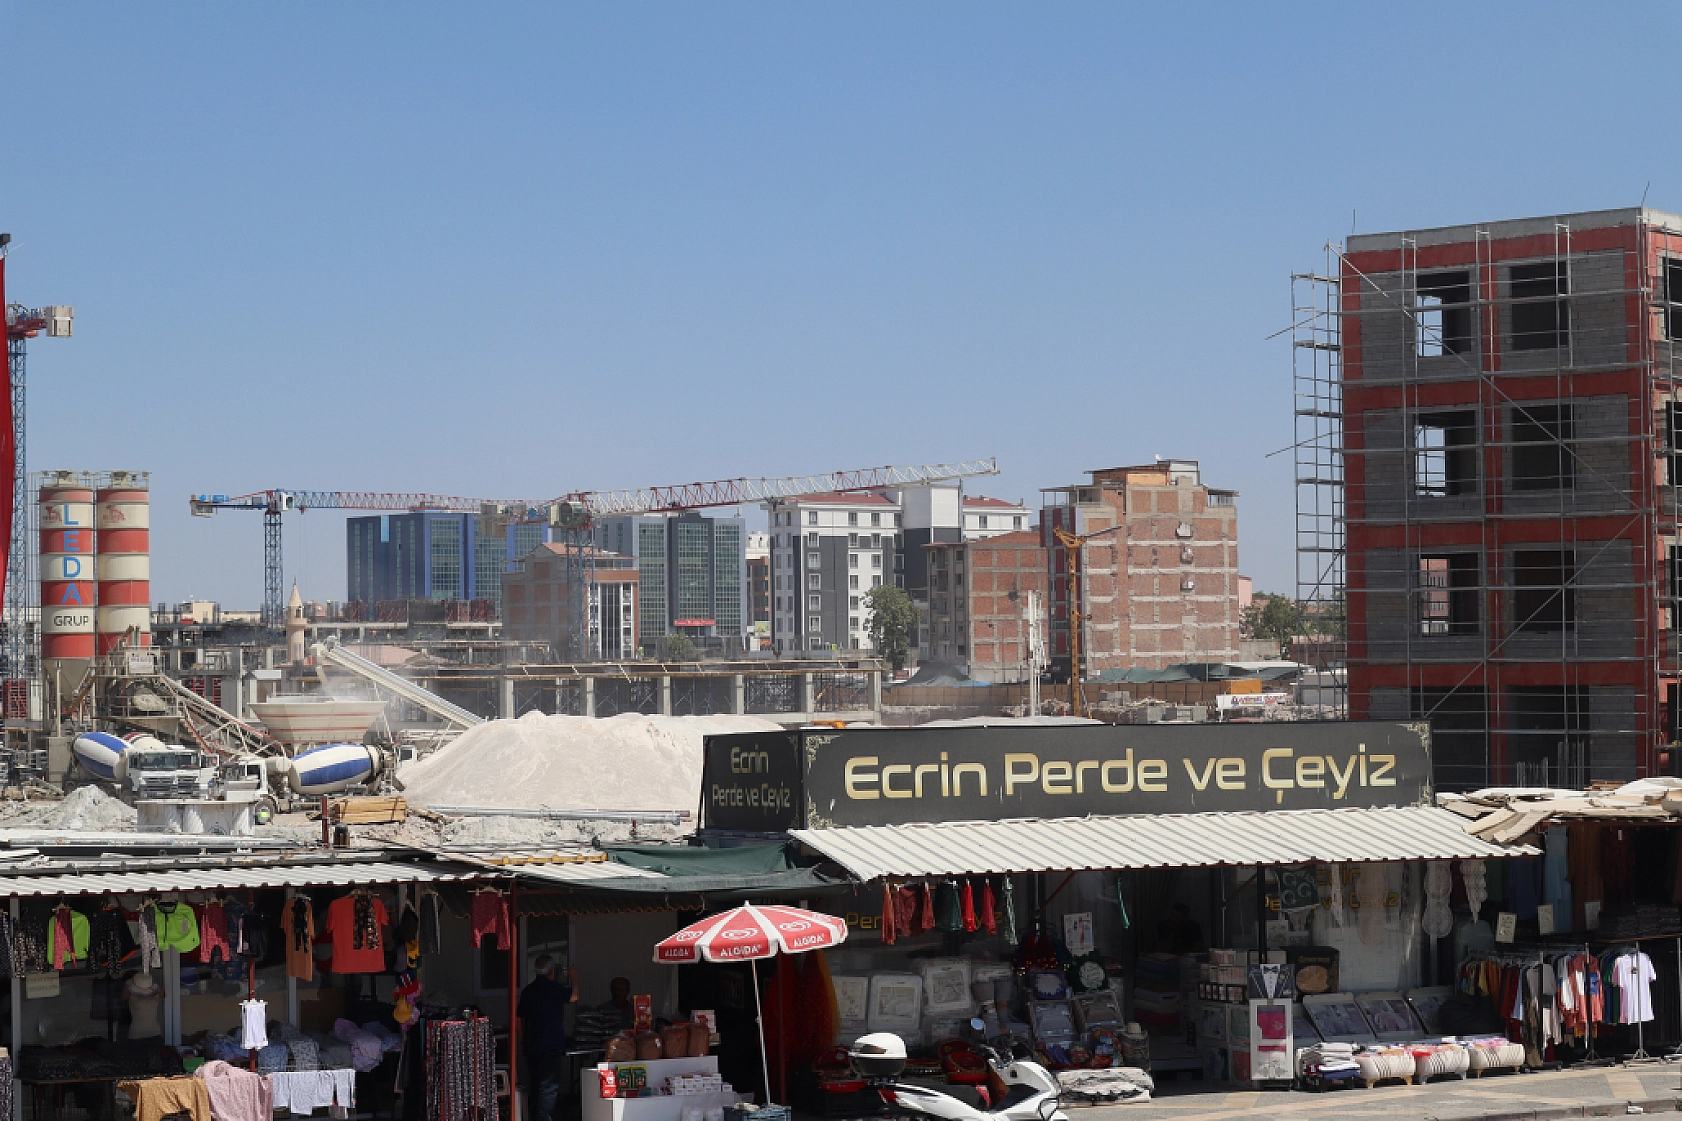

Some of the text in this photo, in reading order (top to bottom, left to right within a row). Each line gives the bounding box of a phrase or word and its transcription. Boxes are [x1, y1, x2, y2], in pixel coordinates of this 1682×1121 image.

[60, 503, 83, 605] LEDA
[53, 615, 90, 627] GRUP
[731, 744, 769, 774] Ecrin
[844, 743, 1397, 805] Ecrin Perde ve Çeyiz
[713, 781, 790, 814] Perde ve Çeyiz
